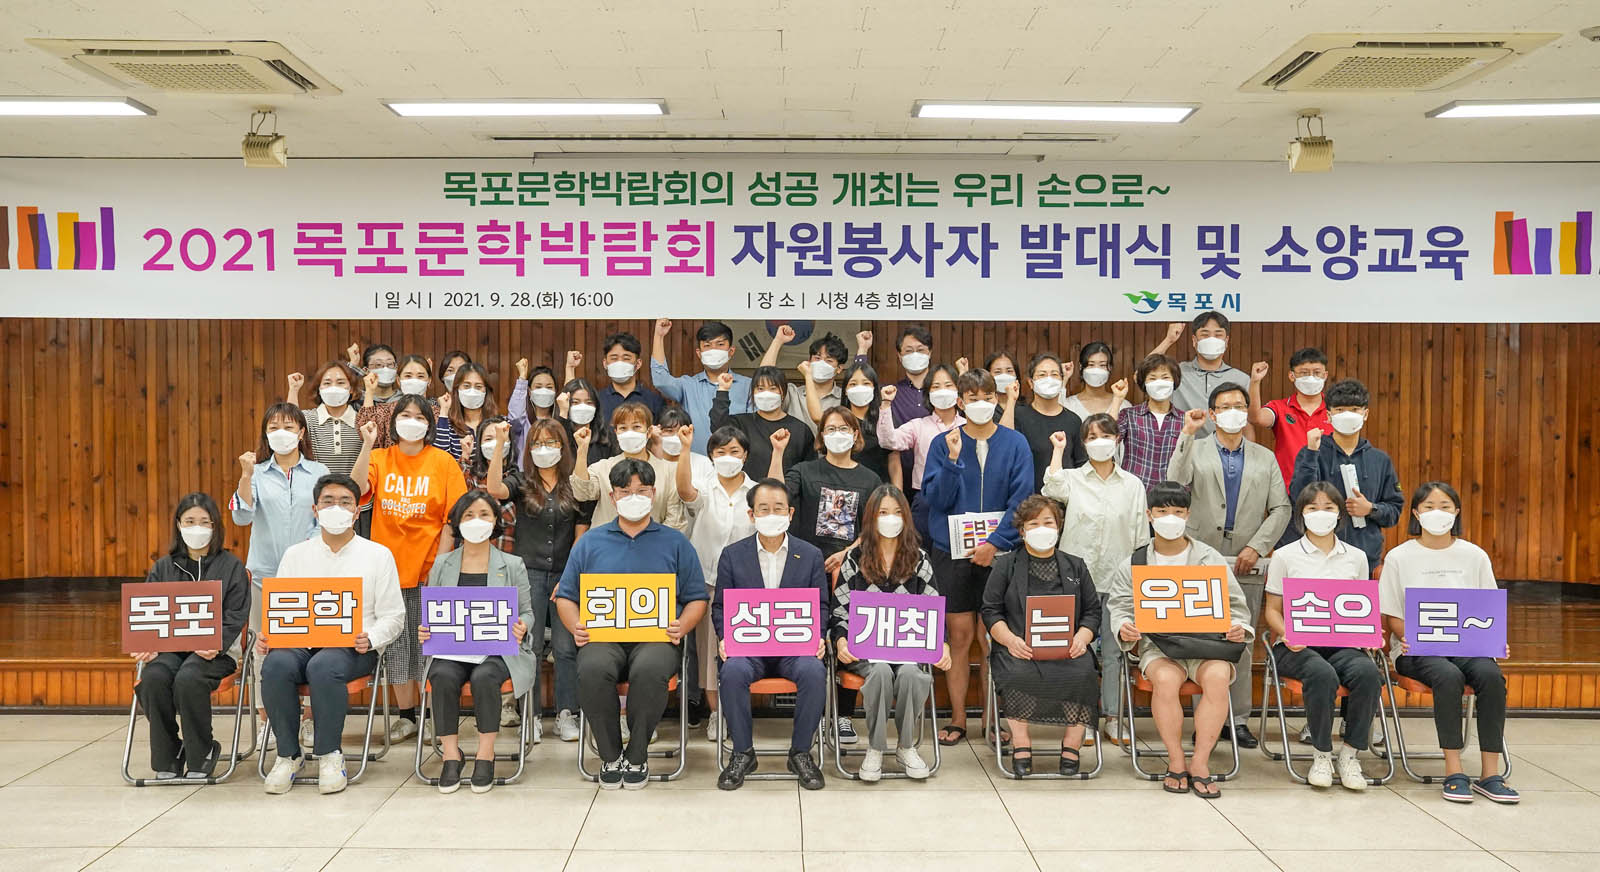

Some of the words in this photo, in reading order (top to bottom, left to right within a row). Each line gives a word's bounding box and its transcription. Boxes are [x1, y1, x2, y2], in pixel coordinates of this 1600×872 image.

[444, 171, 733, 206] 목포문학박람회의
[748, 172, 818, 206] 성공
[833, 172, 939, 207] 개최는
[953, 173, 1023, 207] 우리
[1037, 173, 1170, 207] 손으로~
[143, 228, 275, 271] 2021
[294, 219, 715, 277] 목포문학박람회
[731, 222, 998, 278] 자원봉사자
[1021, 223, 1171, 279] 발대식
[1197, 224, 1241, 279] 및
[1262, 225, 1469, 280] 소양교육
[444, 293, 484, 307] 2021.
[491, 293, 504, 307] 9.
[511, 292, 563, 309] 28.(화)
[570, 292, 613, 306] 16:00
[817, 292, 848, 309] 시청
[855, 292, 880, 309] 4층
[887, 292, 933, 310] 회의실
[1167, 293, 1240, 312] 목포시
[384, 472, 430, 497] CALM
[128, 594, 216, 638] 목포
[267, 590, 358, 635] 문학
[585, 586, 670, 629] 회의
[1139, 578, 1225, 620] 우리
[1290, 591, 1376, 634] 손으
[427, 599, 513, 642] 박람
[730, 601, 814, 644] 성공
[855, 605, 939, 651] 개최
[1030, 608, 1070, 648] 는
[1416, 601, 1495, 643] 로~
